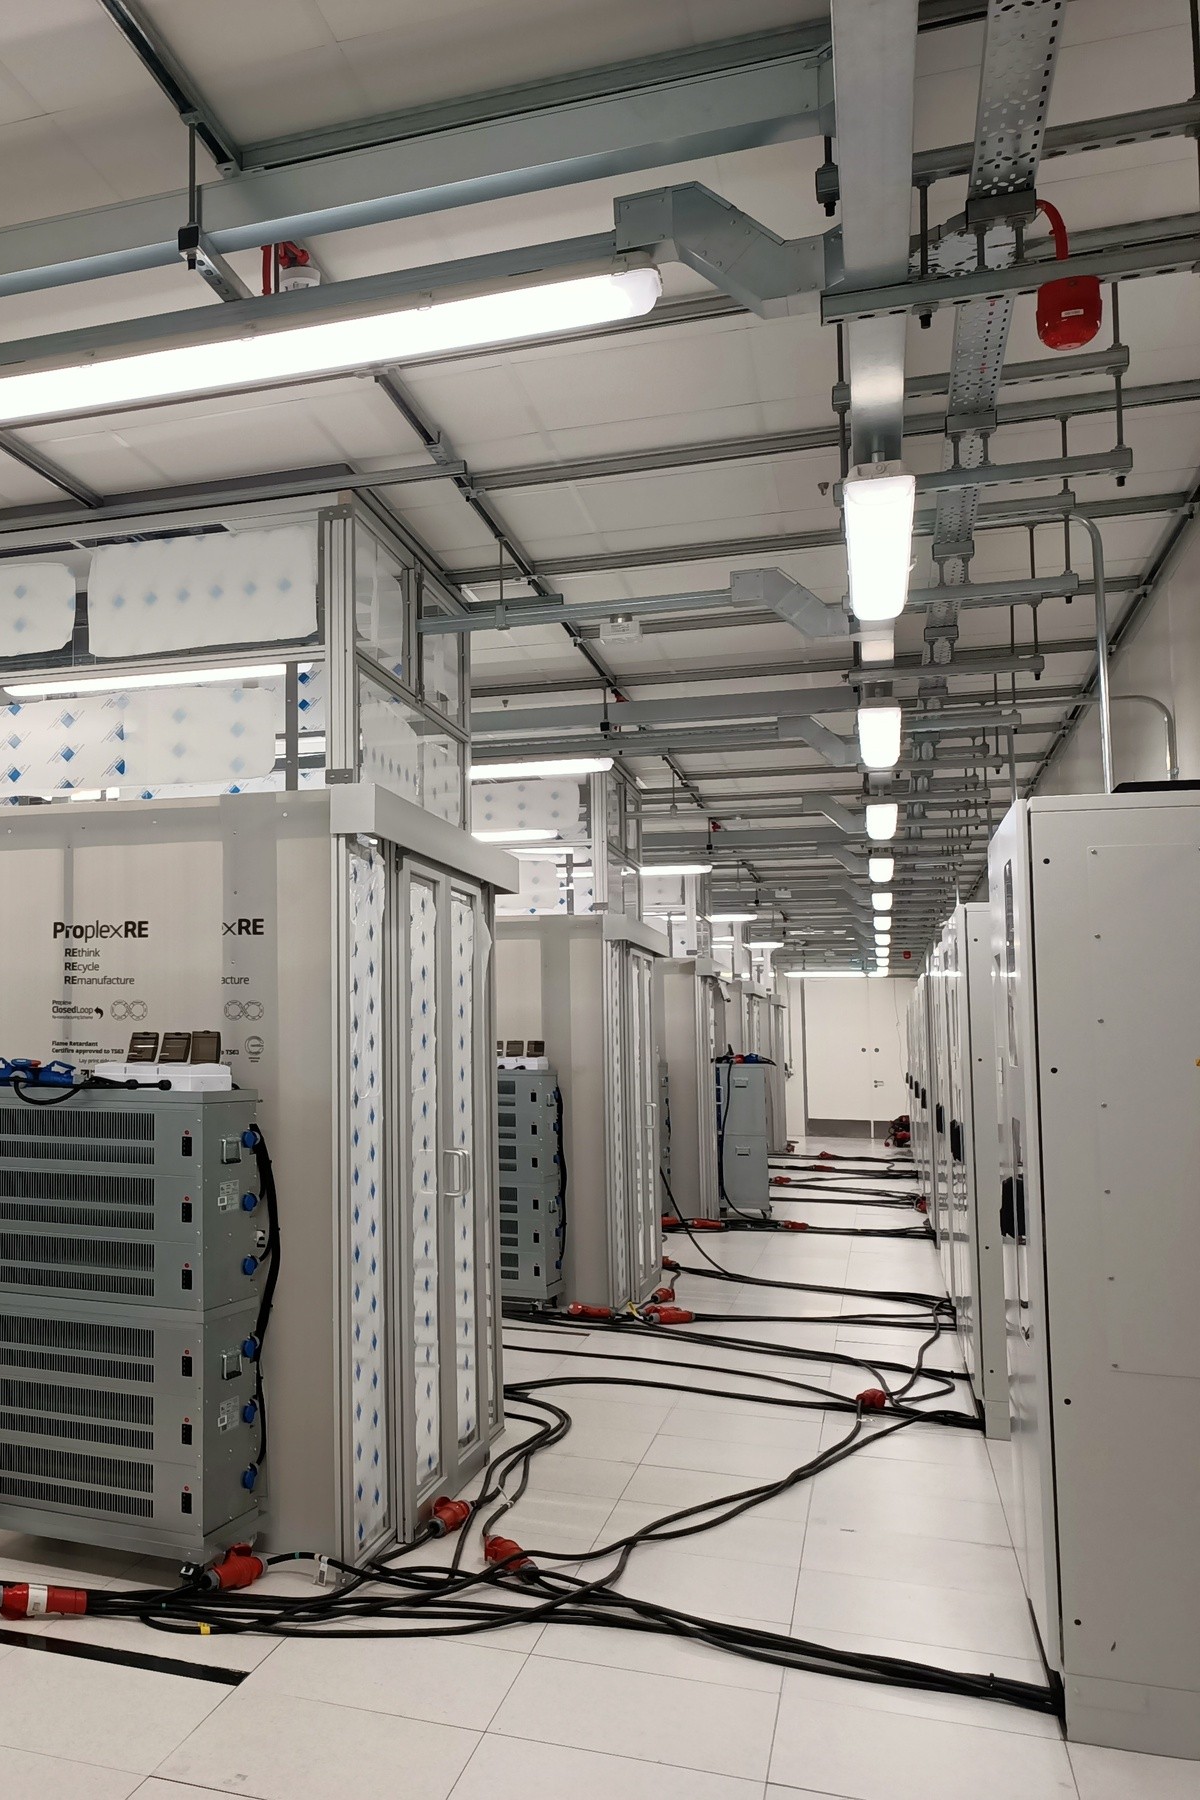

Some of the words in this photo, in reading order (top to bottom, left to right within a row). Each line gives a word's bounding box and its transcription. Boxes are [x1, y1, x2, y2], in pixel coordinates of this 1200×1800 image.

[53, 920, 149, 943] ProplexRE
[64, 948, 100, 957] REthink
[64, 962, 100, 974] REcycle
[64, 975, 135, 985] REmanufacture
[52, 1005, 93, 1015] ClosedLoop
